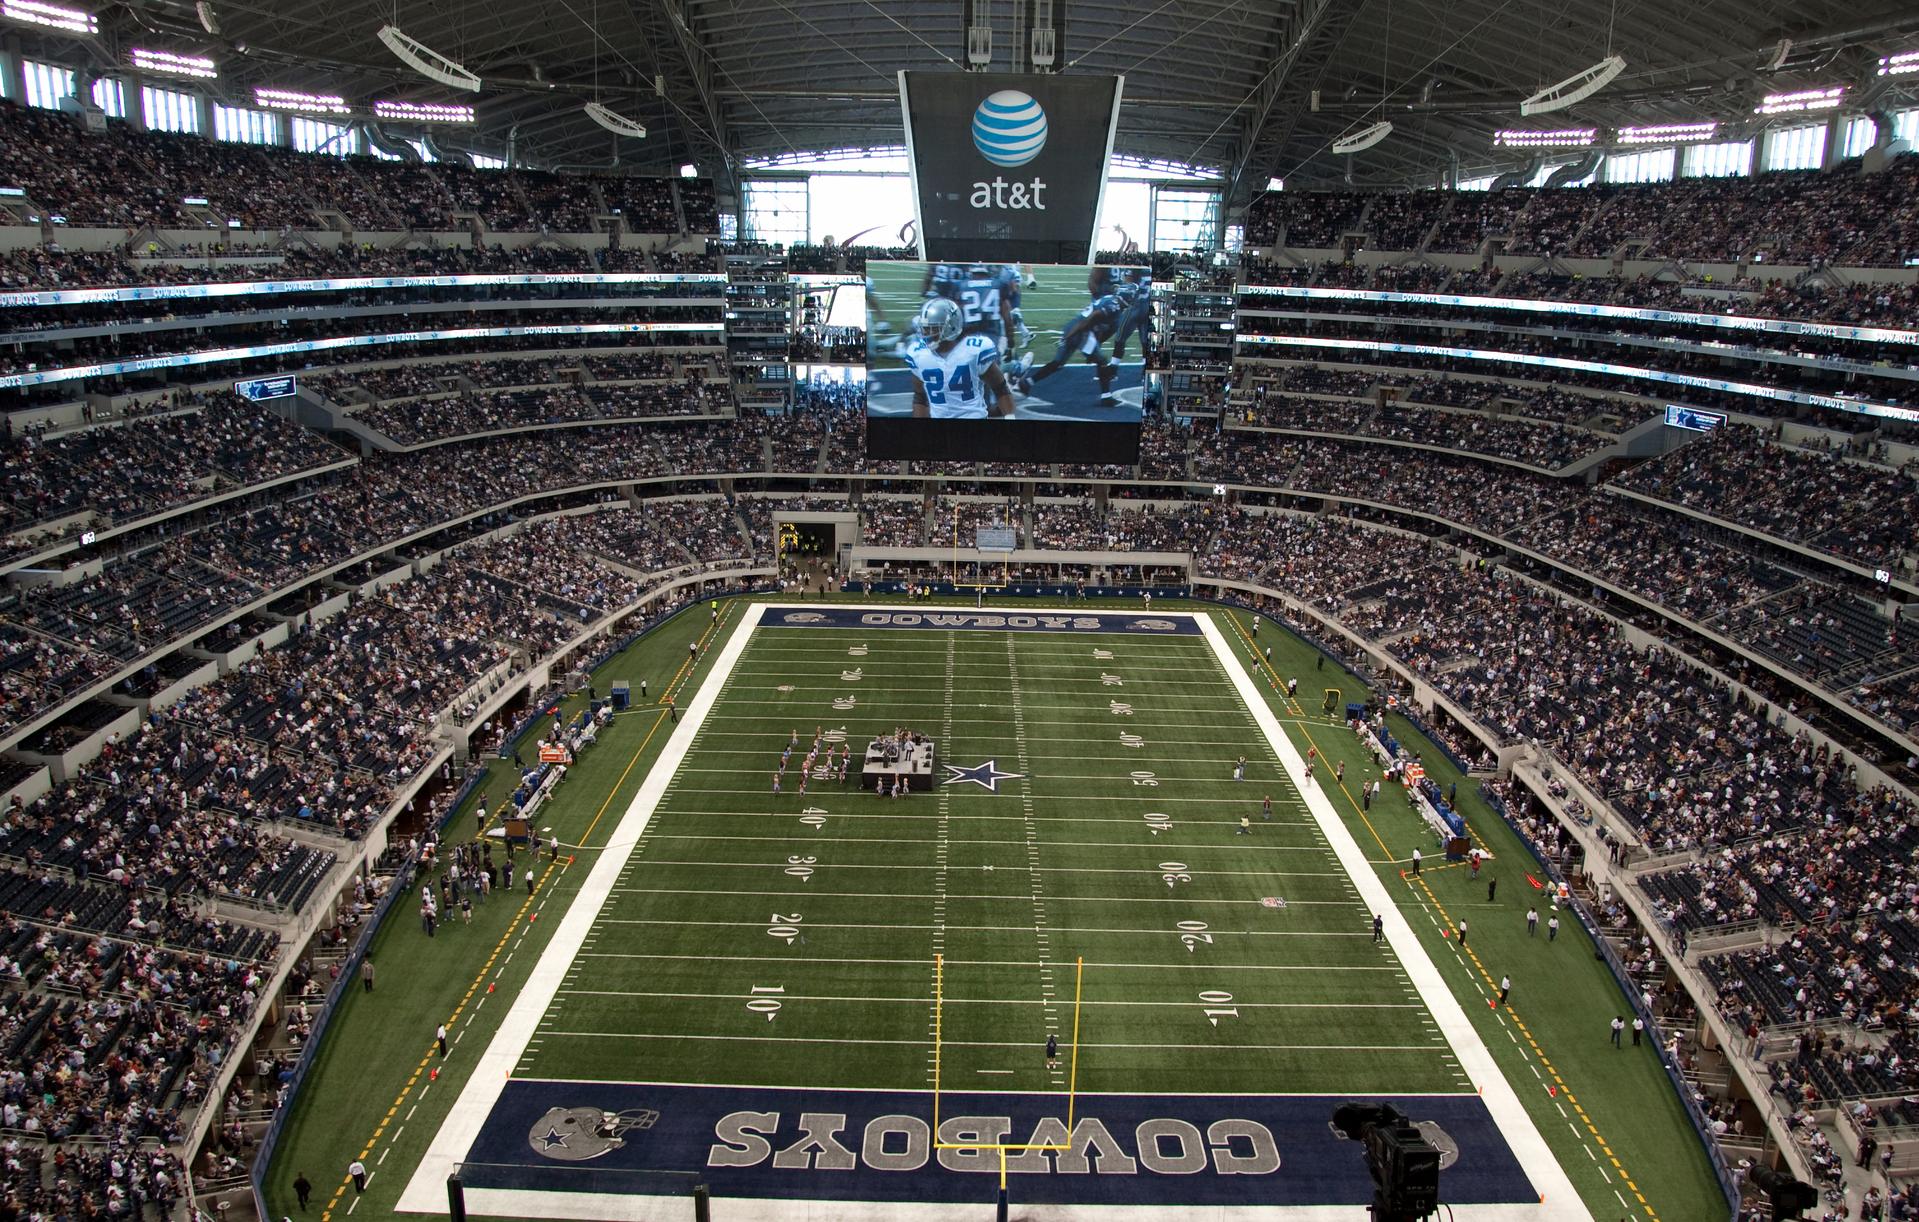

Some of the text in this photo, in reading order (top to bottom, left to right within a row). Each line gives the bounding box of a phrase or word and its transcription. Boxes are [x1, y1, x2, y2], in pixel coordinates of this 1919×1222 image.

[970, 176, 1047, 210] at&t
[0, 293, 40, 306] OWBOYS
[153, 286, 190, 299] COWBOYS
[961, 289, 1000, 322] 24
[1669, 313, 1700, 325] COWBOYS
[524, 325, 562, 334] COWBOYS
[1800, 323, 1837, 337] COWBOYS
[386, 333, 419, 344] COWBOYS
[136, 357, 173, 370] COWBOYS
[921, 364, 976, 404] 24
[1678, 374, 1710, 387] COWBOYS
[1808, 394, 1845, 410] COWBOYS
[1884, 407, 1919, 423] COWBOY
[861, 612, 1102, 629] COWBOYS
[832, 698, 857, 710] 30
[1110, 703, 1134, 715] 30
[822, 729, 848, 742] 40
[1119, 734, 1145, 748] 40
[1130, 771, 1159, 787] 50
[799, 807, 829, 824] 40
[1143, 813, 1173, 830] 40
[784, 855, 817, 876] 30
[1158, 862, 1192, 882] 30
[767, 913, 803, 937] 20
[1176, 920, 1214, 944] 20
[746, 984, 785, 1012] 10
[1198, 990, 1239, 1018] 10
[707, 1111, 1281, 1175] COWBOYS
